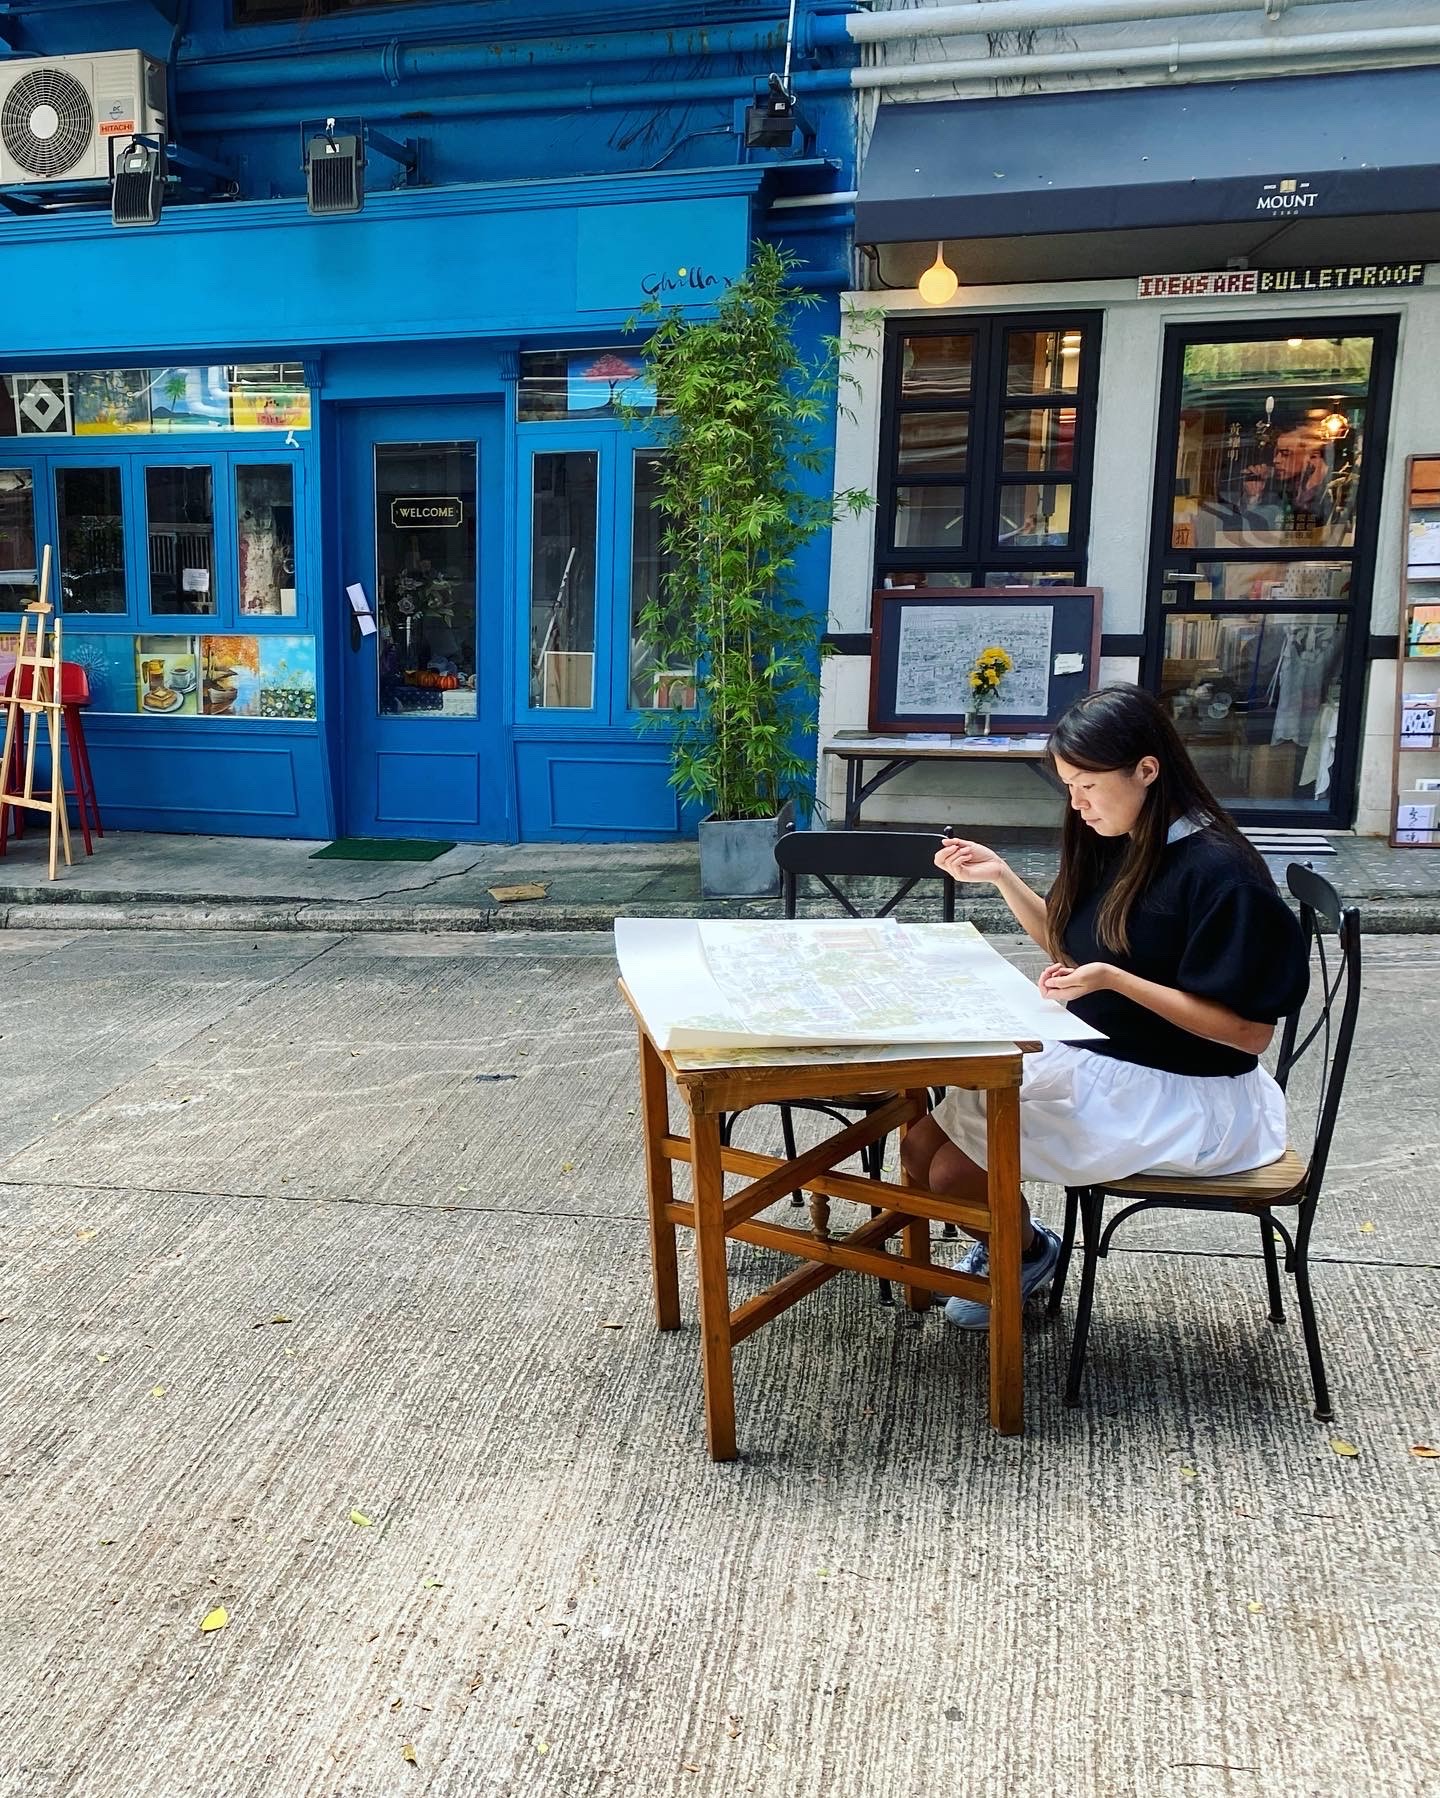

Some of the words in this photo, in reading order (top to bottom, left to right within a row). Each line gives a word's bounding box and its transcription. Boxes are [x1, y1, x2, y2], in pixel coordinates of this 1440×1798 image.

[101, 124, 133, 133] HITACHI
[1256, 193, 1318, 210] MOUNT
[1140, 276, 1208, 297] IDEAS
[1213, 273, 1255, 293] ARE
[1260, 265, 1422, 290] BULLETPROOF
[399, 507, 454, 518] WELCOME
